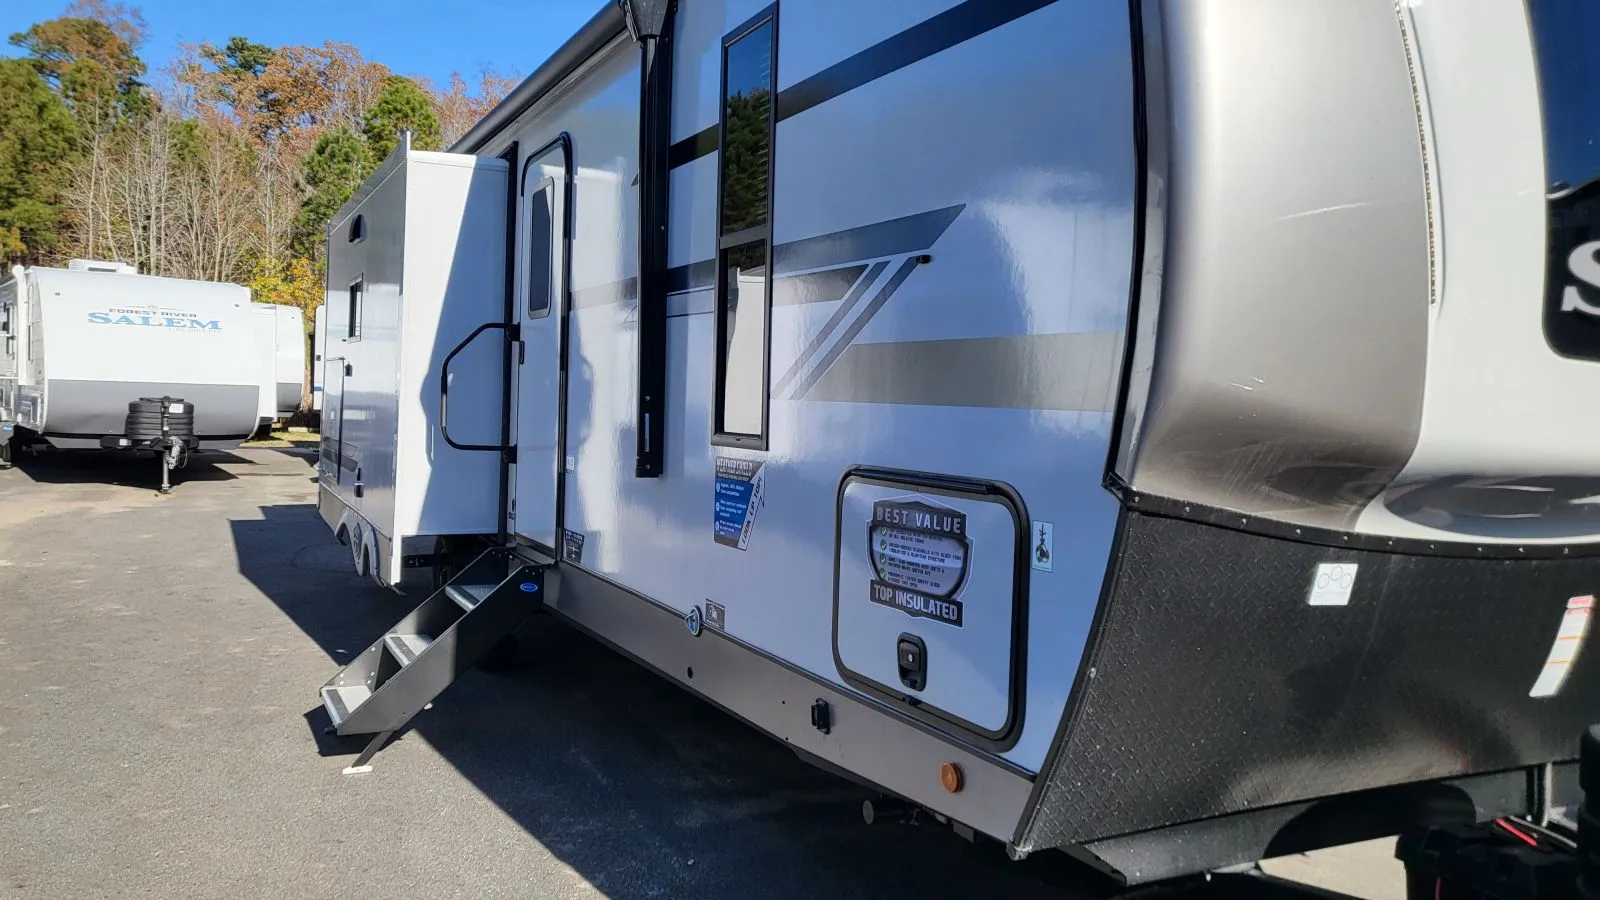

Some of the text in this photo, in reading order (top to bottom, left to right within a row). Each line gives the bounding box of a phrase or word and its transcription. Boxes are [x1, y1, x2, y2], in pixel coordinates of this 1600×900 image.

[87, 312, 222, 330] SALEM
[876, 506, 961, 534] BEST VALUE
[873, 584, 958, 621] TOP INSULATED
